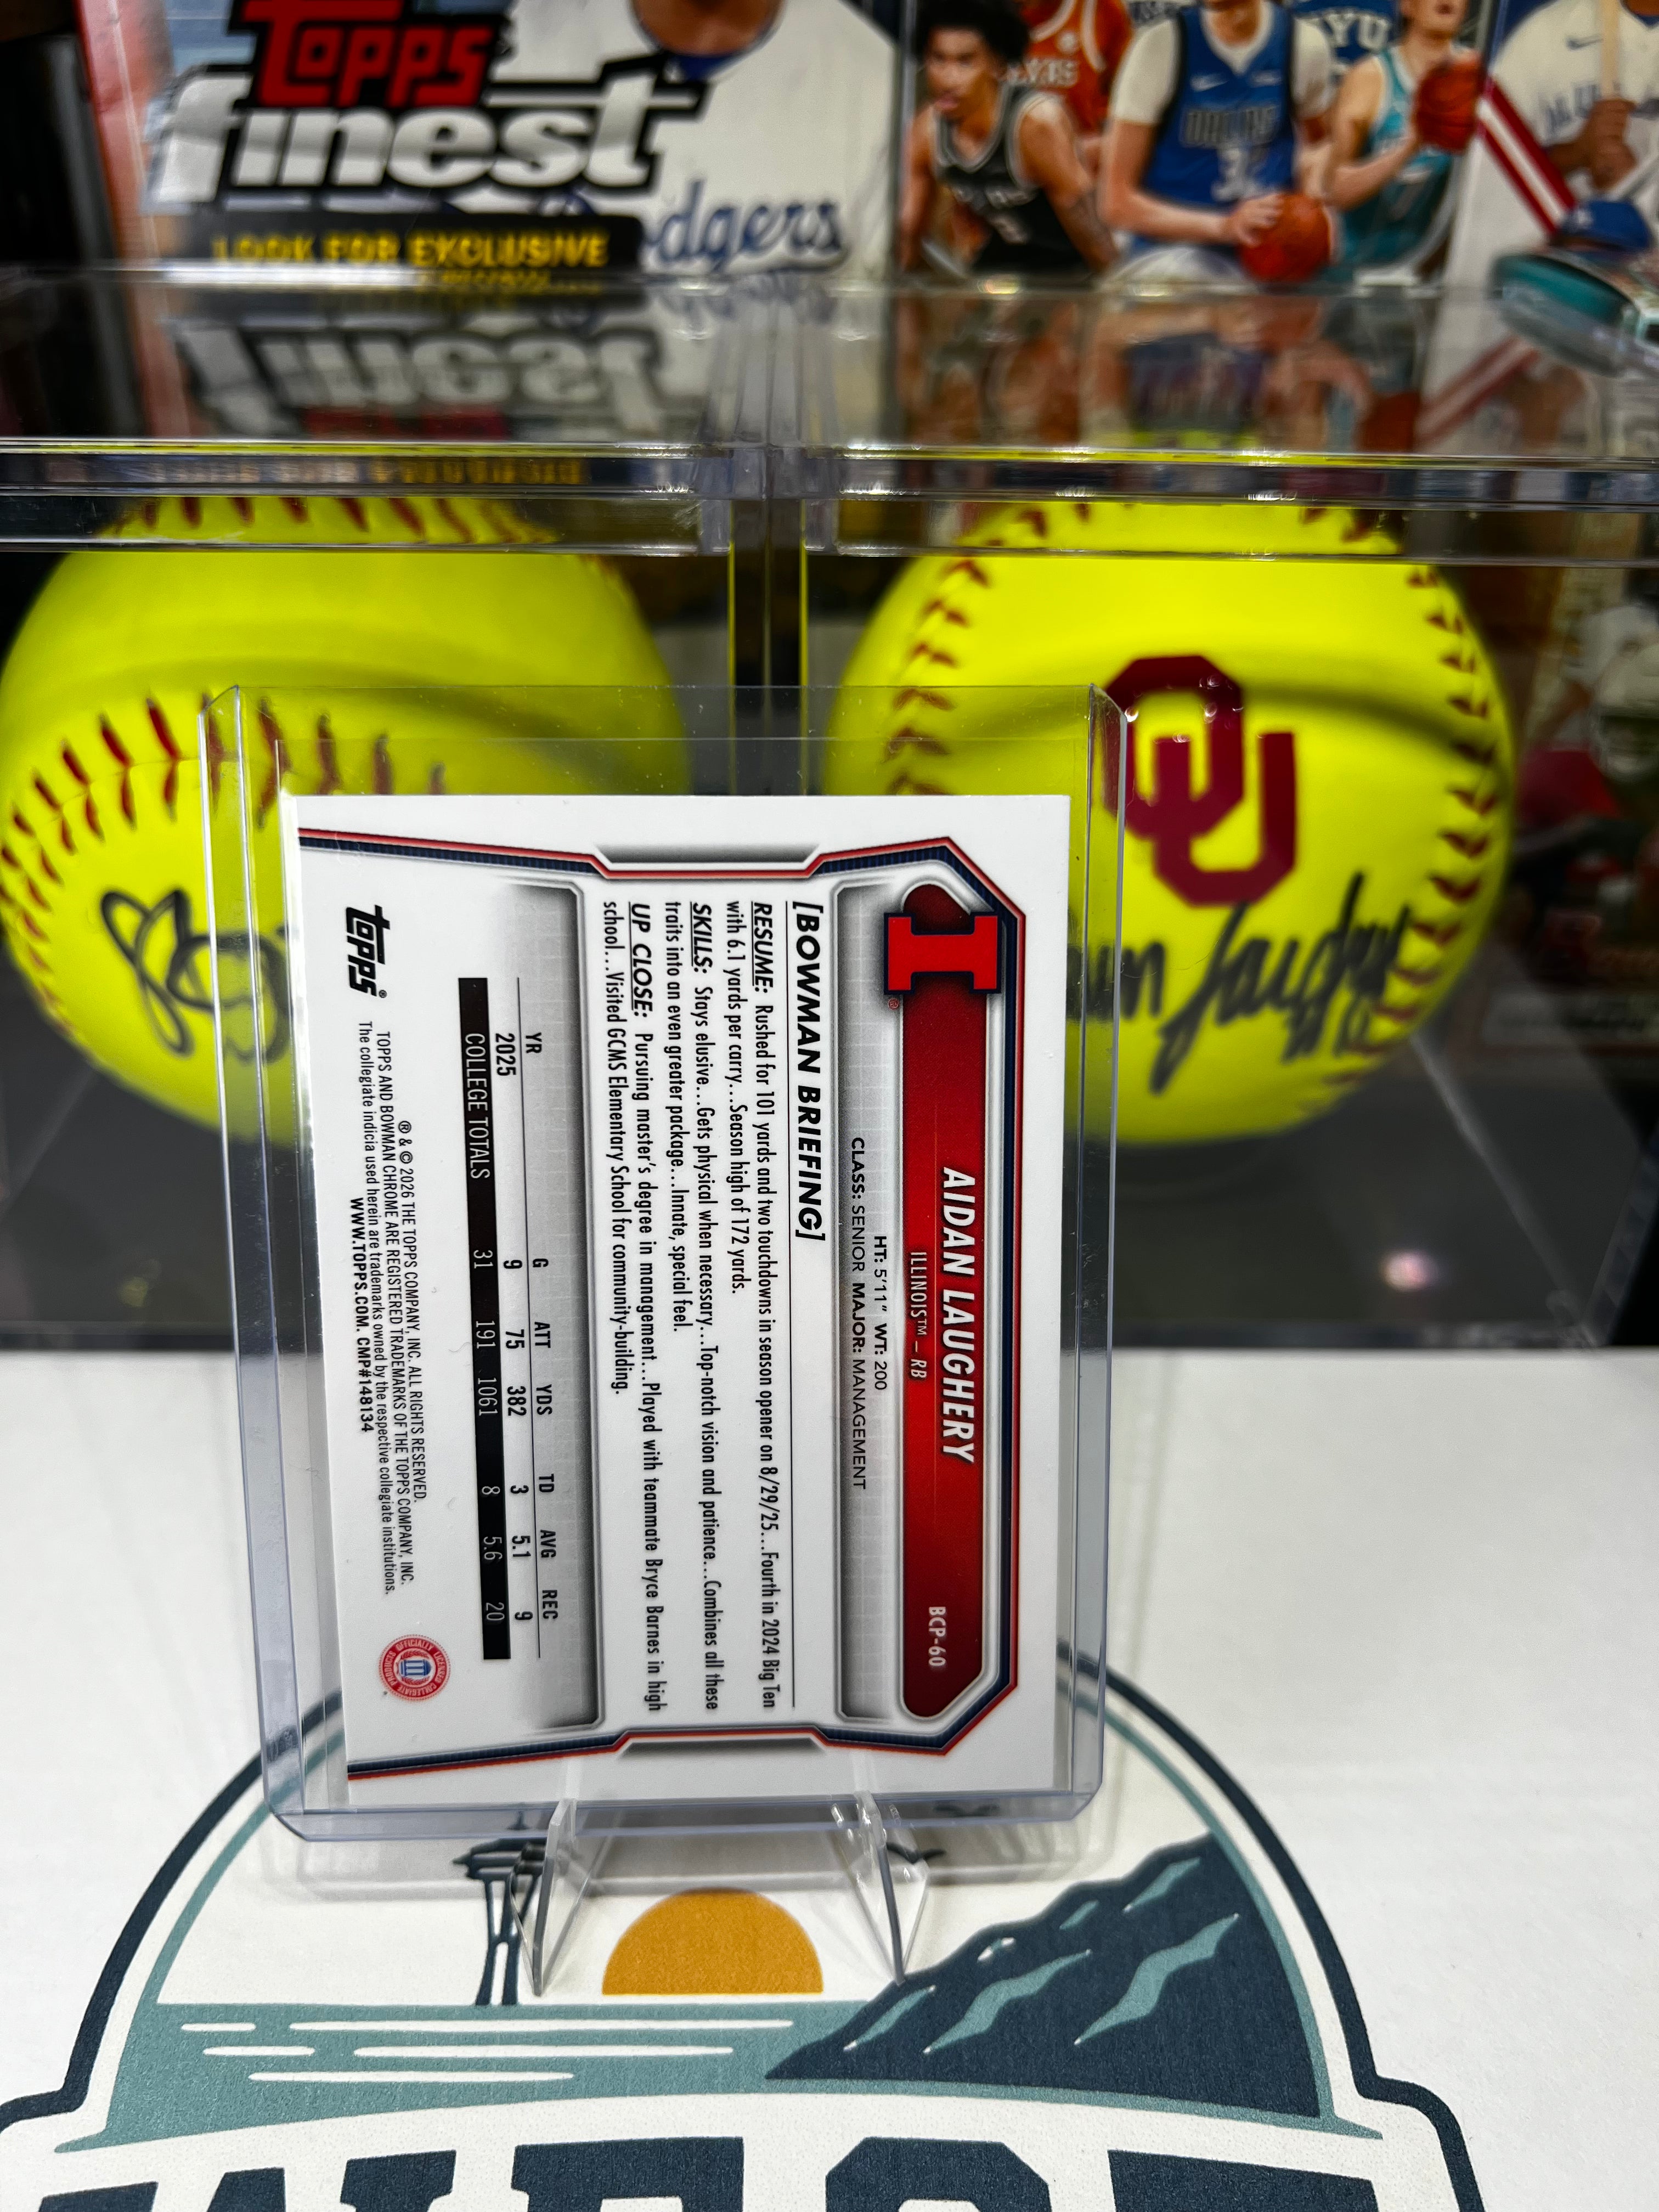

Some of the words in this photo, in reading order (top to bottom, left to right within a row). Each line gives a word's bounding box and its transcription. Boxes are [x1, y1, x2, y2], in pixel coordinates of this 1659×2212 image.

[158, 61, 699, 203] finest
[646, 180, 842, 274] dgers
[212, 232, 314, 264] LOOK
[324, 230, 400, 266] FOR
[408, 228, 609, 267] EXCLUSIVE
[631, 904, 651, 933] UP
[665, 902, 683, 941] traits
[727, 901, 747, 933] with
[690, 902, 713, 973] SKILLS:
[727, 940, 746, 960] 6.1
[751, 901, 773, 993] RESUME:
[667, 947, 684, 976] into
[632, 944, 653, 1017] CLOSE:
[667, 982, 680, 999] an
[724, 968, 748, 1009] yards
[793, 901, 823, 1074] [BOWMAN
[668, 1006, 681, 1040] even
[691, 987, 713, 1026] Stays
[359, 1022, 373, 1042] The
[526, 1032, 542, 1053] YR
[725, 1015, 741, 1039] per
[755, 1006, 776, 1058] Rushed
[377, 1032, 391, 1071] TOPPS
[496, 1033, 516, 1076] 2025
[607, 1029, 627, 1070] GCMS
[631, 1034, 653, 1100] Pursuing
[360, 1048, 375, 1106] collegiate
[379, 1076, 393, 1100] AND
[465, 1033, 488, 1111] COLLEGE
[665, 1046, 685, 1100] greater
[757, 1064, 776, 1085] for
[606, 1077, 629, 1160] Elementary
[757, 1092, 775, 1114] 101
[364, 1112, 377, 1151] indicia
[381, 1106, 396, 1160] BOWMAN
[468, 1117, 490, 1179] TOTALS
[637, 1109, 656, 1173] master's
[753, 1123, 776, 1163] yards
[365, 1156, 380, 1183] used
[693, 1146, 718, 1204] physical
[726, 1162, 750, 1192] high
[795, 1085, 825, 1240] BRIEFING]
[851, 1138, 865, 1199] CLASS:
[383, 1166, 398, 1217] CHROME
[400, 1169, 414, 1198] 2026
[611, 1166, 631, 1212] School
[757, 1169, 777, 1194] and
[368, 1189, 381, 1225] herein
[402, 1203, 416, 1224] THE
[634, 1182, 658, 1233] degree
[731, 1199, 751, 1212] of
[758, 1200, 773, 1225] two
[944, 1167, 975, 1274] AIDAN
[369, 1231, 379, 1248] are
[386, 1222, 399, 1245] ARE
[612, 1218, 631, 1239] for
[699, 1210, 718, 1248] when
[732, 1219, 749, 1244] 172
[851, 1205, 865, 1272] SENIOR
[351, 1198, 369, 1331] WWW.TOPPS.COM.
[403, 1229, 417, 1267] TOPPS
[473, 1249, 493, 1269] 31
[504, 1260, 522, 1269] 9
[533, 1259, 549, 1267] G
[640, 1242, 657, 1254] in
[874, 1237, 887, 1262] HT:
[370, 1252, 385, 1319] trademarks
[387, 1250, 402, 1324] REGISTERED
[669, 1246, 692, 1294] special
[727, 1250, 752, 1293] yards.
[758, 1231, 778, 1314] touchdowns
[404, 1272, 420, 1333] COMPANY,
[610, 1245, 635, 1394] community-building.
[674, 1300, 693, 1331] feel.
[852, 1283, 865, 1352] MAJOR:
[373, 1324, 387, 1360] owned
[476, 1321, 495, 1348] 191
[506, 1329, 524, 1348] 75
[534, 1322, 551, 1348] ATT
[759, 1320, 776, 1331] in
[874, 1323, 887, 1355] WT:
[408, 1339, 421, 1361] INC.
[759, 1338, 771, 1385] season
[357, 1338, 374, 1432] CMP#148134
[373, 1366, 388, 1377] by
[391, 1328, 406, 1409] TRADEMARKS
[409, 1367, 421, 1387] ALL
[875, 1361, 887, 1390] 200
[911, 1359, 927, 1378] RB
[943, 1290, 974, 1462] LAUGHERY
[376, 1381, 388, 1399] the
[478, 1378, 498, 1415] 1061
[507, 1386, 527, 1416] 382
[537, 1384, 552, 1415] YDS
[394, 1414, 407, 1427] OF
[410, 1392, 424, 1434] RIGHTS
[755, 1391, 772, 1440] opener
[853, 1359, 866, 1489] MANAGEMENT
[375, 1404, 391, 1463] respective
[395, 1431, 408, 1453] THE
[702, 1422, 718, 1463] vision
[411, 1438, 426, 1502] RESERVED.
[644, 1440, 663, 1470] with
[760, 1445, 772, 1461] on
[396, 1458, 410, 1494] TOPPS
[482, 1486, 500, 1494] 8
[510, 1485, 529, 1494] 3
[539, 1474, 554, 1492] TD
[702, 1469, 722, 1494] and
[379, 1468, 394, 1522] collegiate
[398, 1499, 413, 1557] COMPANY,
[644, 1478, 660, 1550] teammate
[383, 1527, 396, 1594] institutions.
[484, 1537, 503, 1560] 5.6
[512, 1536, 531, 1557] 5.1
[540, 1530, 556, 1558] AVG
[401, 1562, 414, 1584] INC.
[641, 1559, 663, 1598] Bryce
[486, 1602, 505, 1621] 20
[515, 1612, 533, 1620] 9
[543, 1590, 558, 1619] REC
[763, 1602, 778, 1613] in
[647, 1606, 663, 1654] Barnes
[763, 1620, 780, 1654] 2024
[929, 1607, 946, 1666] BCP-60
[648, 1661, 664, 1673] in
[706, 1652, 724, 1668] all
[759, 1660, 780, 1680] Big
[644, 1681, 667, 1711] high
[706, 1674, 724, 1709] these
[763, 1685, 780, 1707] Ten
